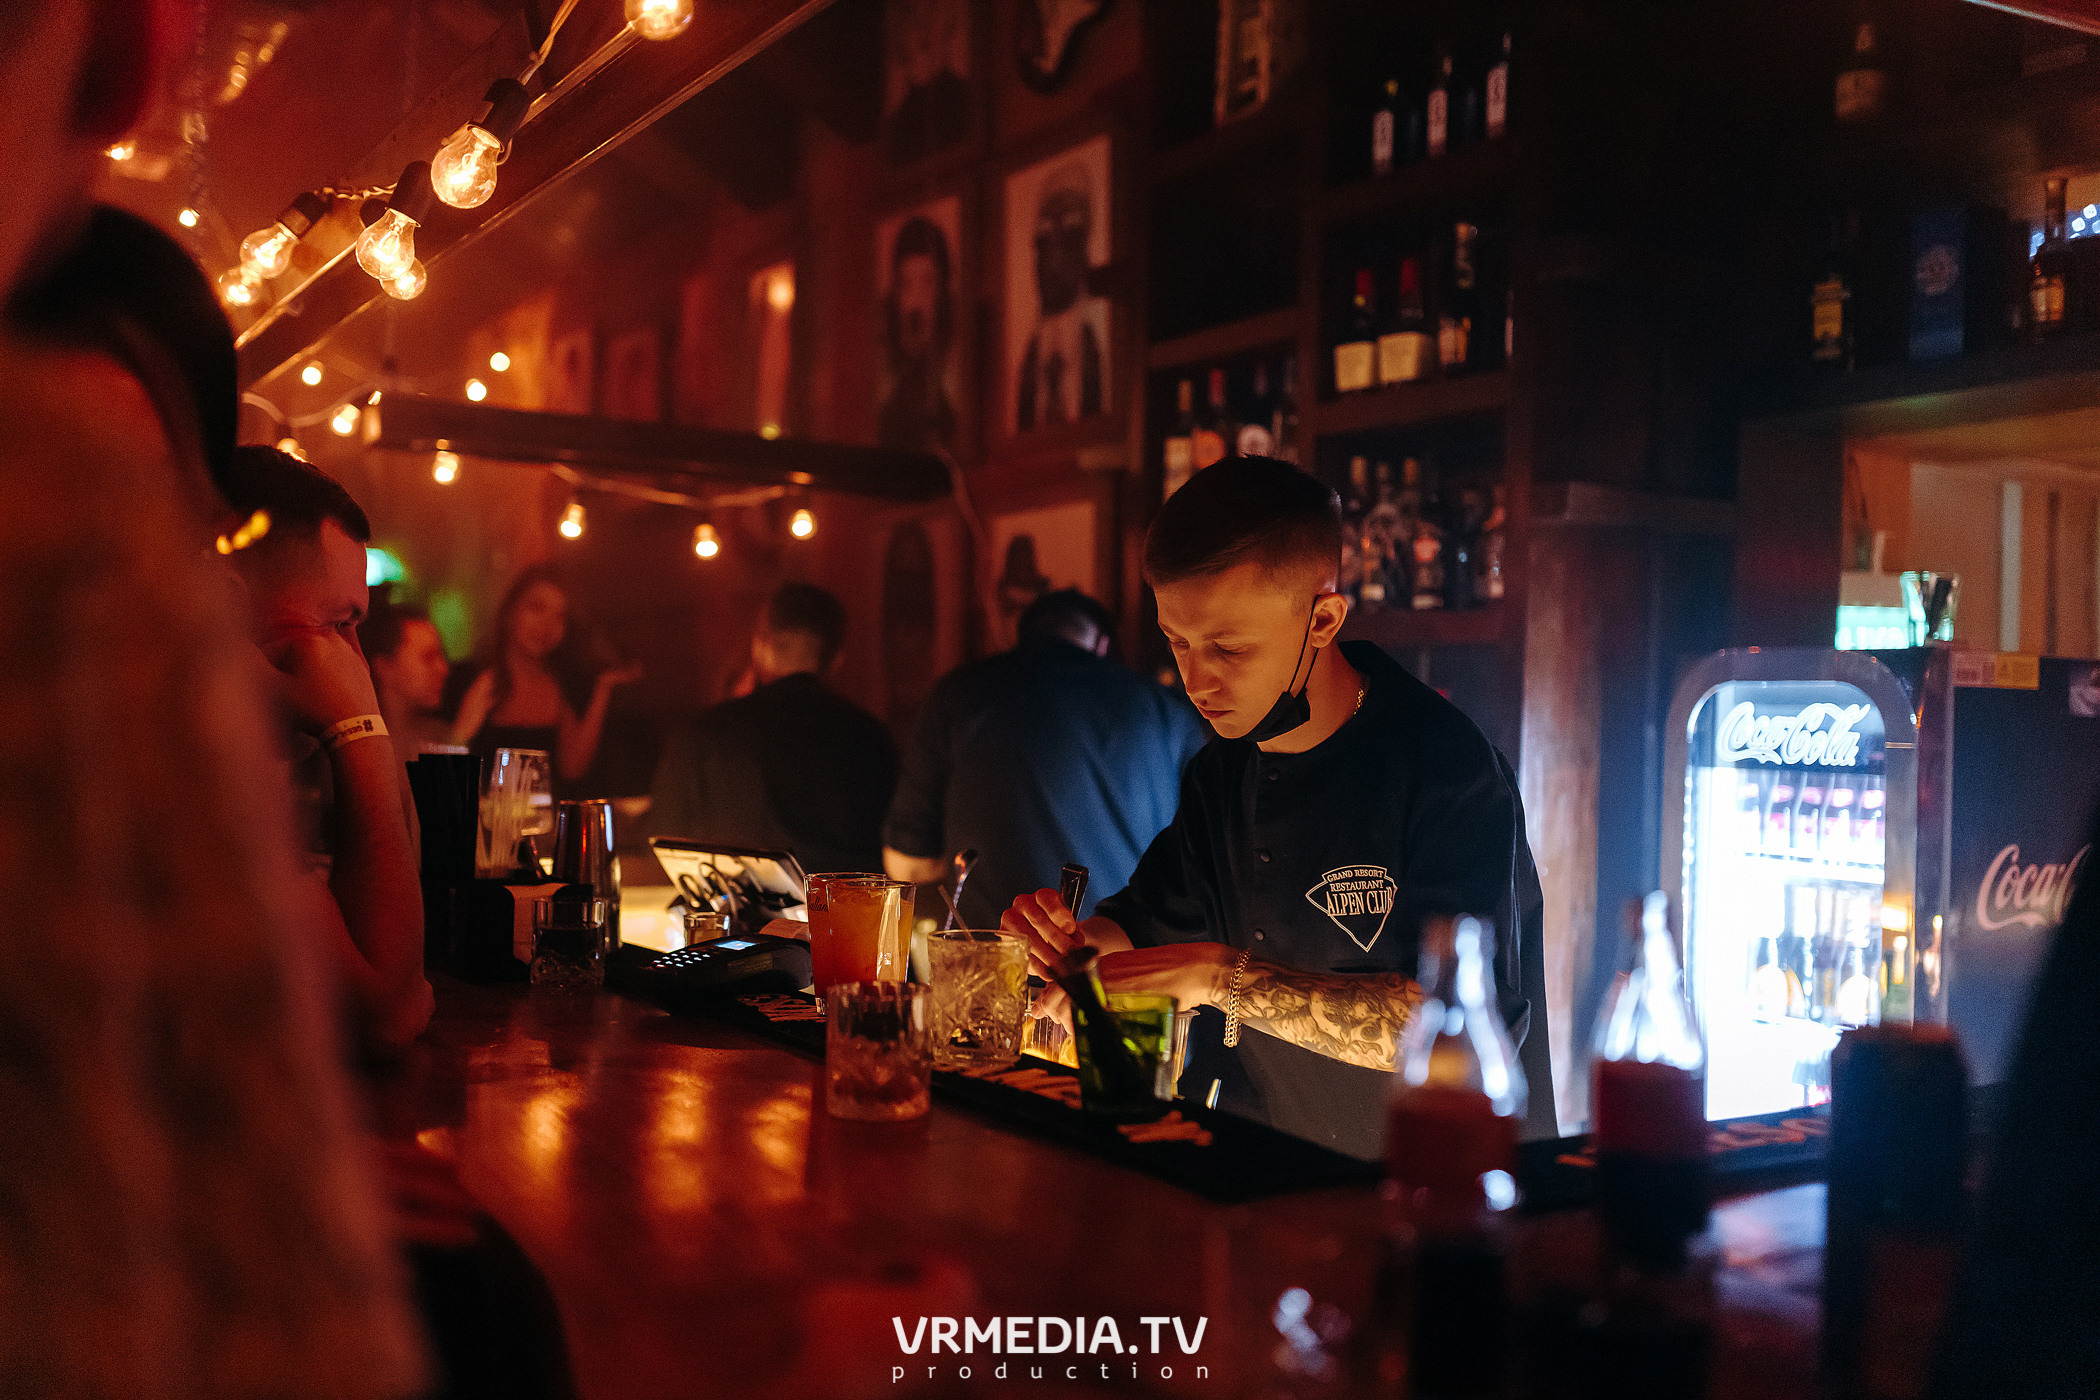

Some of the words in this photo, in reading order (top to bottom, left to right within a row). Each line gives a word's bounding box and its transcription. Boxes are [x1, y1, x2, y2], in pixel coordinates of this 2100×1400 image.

[1716, 701, 1871, 766] Coca-Cola
[1327, 870, 1353, 882] GRAND
[1354, 868, 1384, 878] RESORT
[1330, 880, 1384, 892] RESTAURANT
[1326, 891, 1365, 916] ALPEN
[1366, 886, 1394, 914] CLUB
